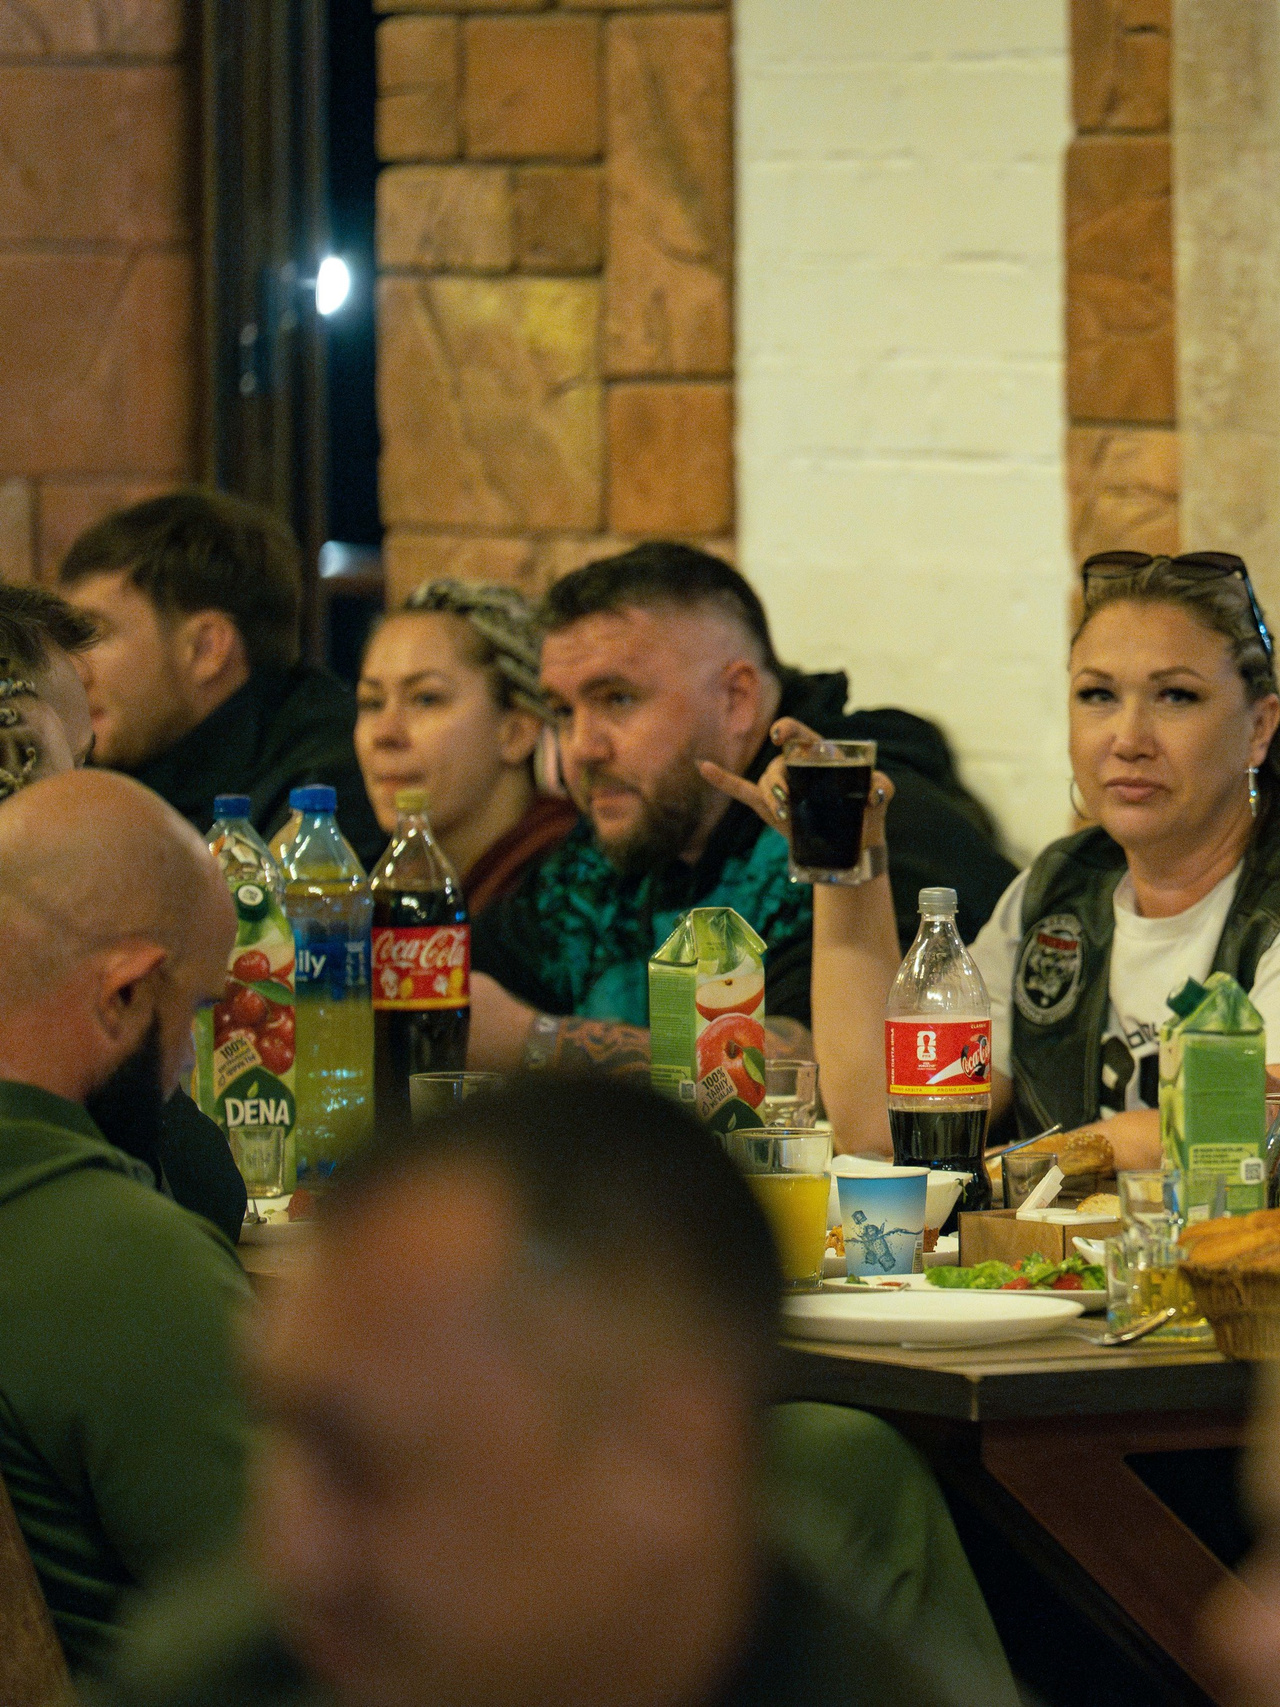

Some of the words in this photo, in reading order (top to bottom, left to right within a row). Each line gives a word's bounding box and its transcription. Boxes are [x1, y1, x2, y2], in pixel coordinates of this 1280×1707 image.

[298, 949, 328, 979] ily
[702, 1067, 726, 1089] 100%
[224, 1098, 291, 1128] DENA
